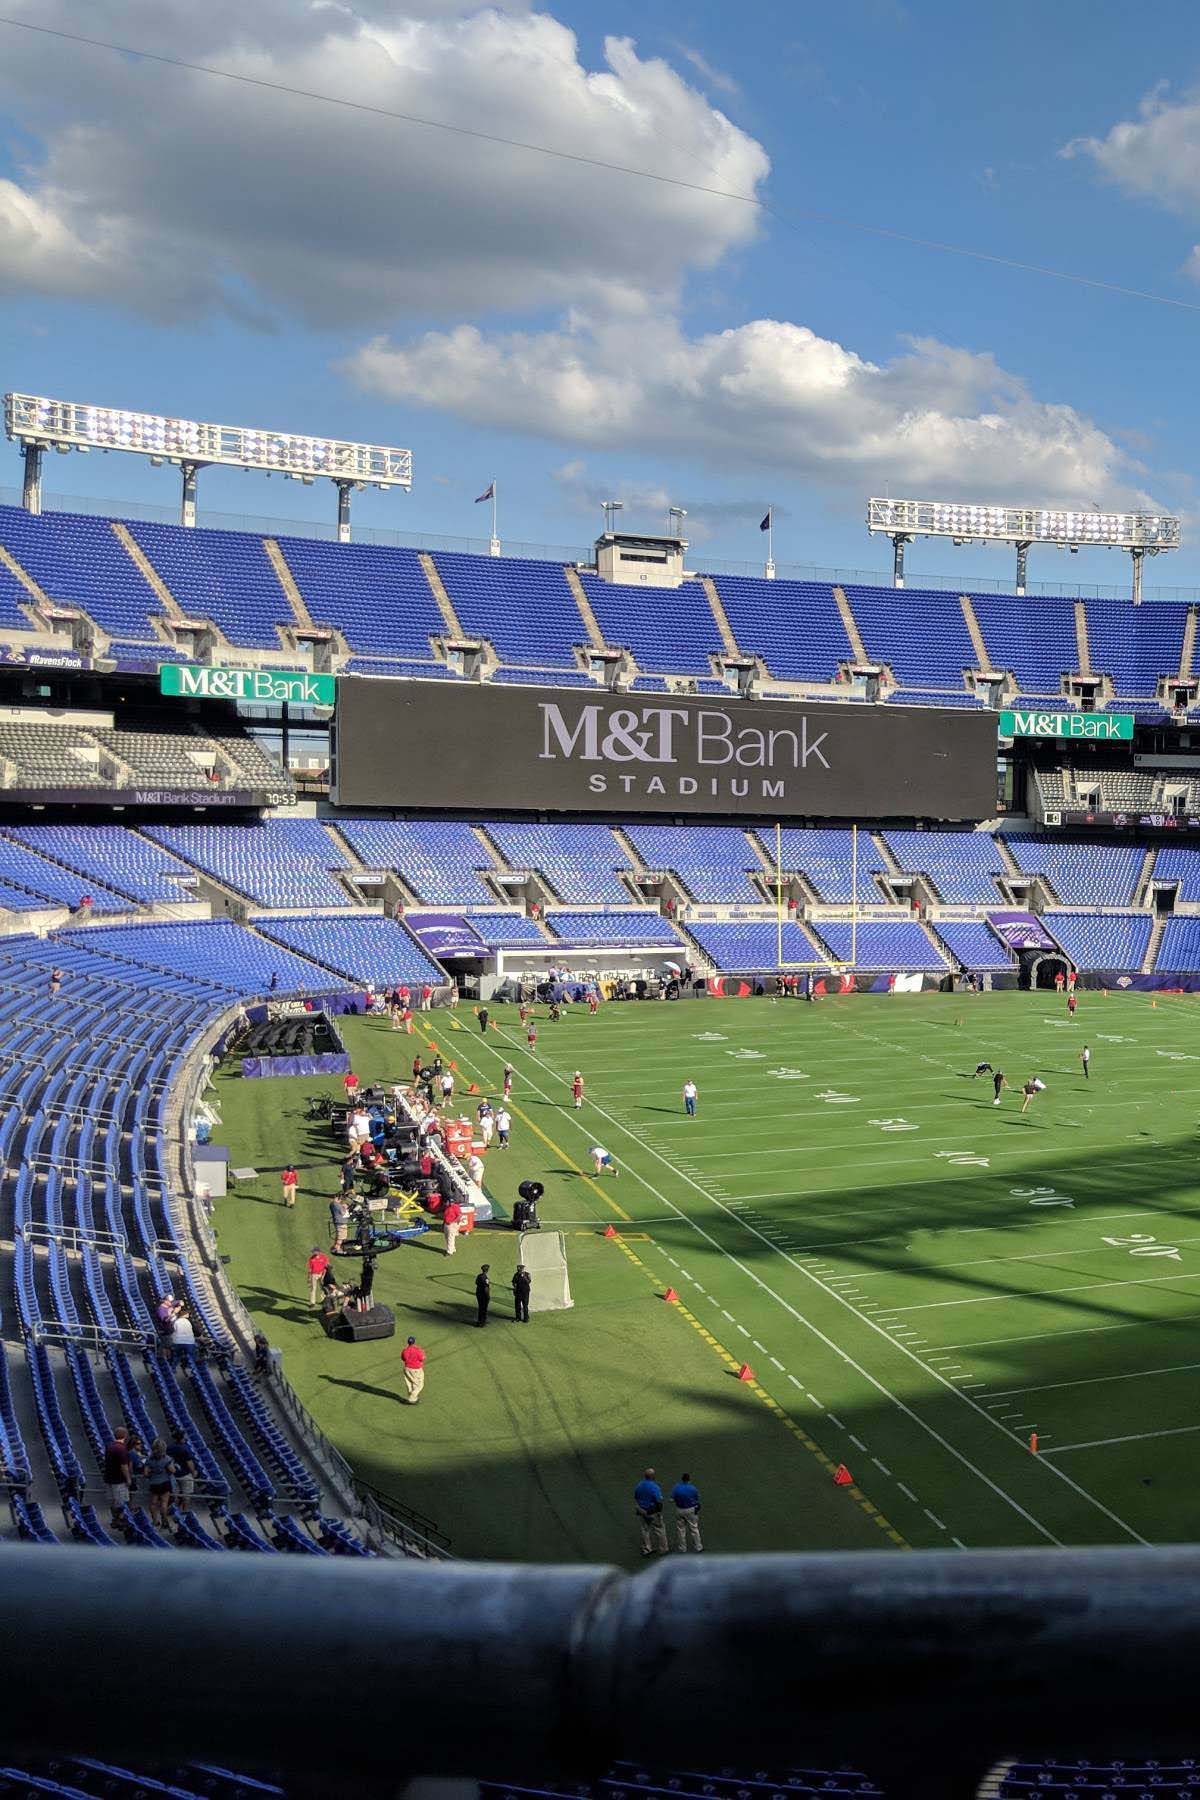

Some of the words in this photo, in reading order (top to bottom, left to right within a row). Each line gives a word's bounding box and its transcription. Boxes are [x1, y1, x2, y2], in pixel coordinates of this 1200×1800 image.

[30, 655, 82, 668] #RavensFlock
[179, 667, 250, 697] M&T
[253, 672, 320, 701] Bank
[538, 703, 688, 763] M&T
[698, 711, 831, 769] Bank
[1013, 713, 1068, 735] M&T
[1069, 715, 1121, 738] Bank
[136, 791, 162, 804] M&T
[163, 792, 190, 804] Bank
[191, 792, 236, 805] Stadium
[589, 774, 785, 798] STADIUM
[932, 1151, 990, 1167] 40
[1010, 1186, 1076, 1209] 30
[1100, 1233, 1183, 1261] 20
